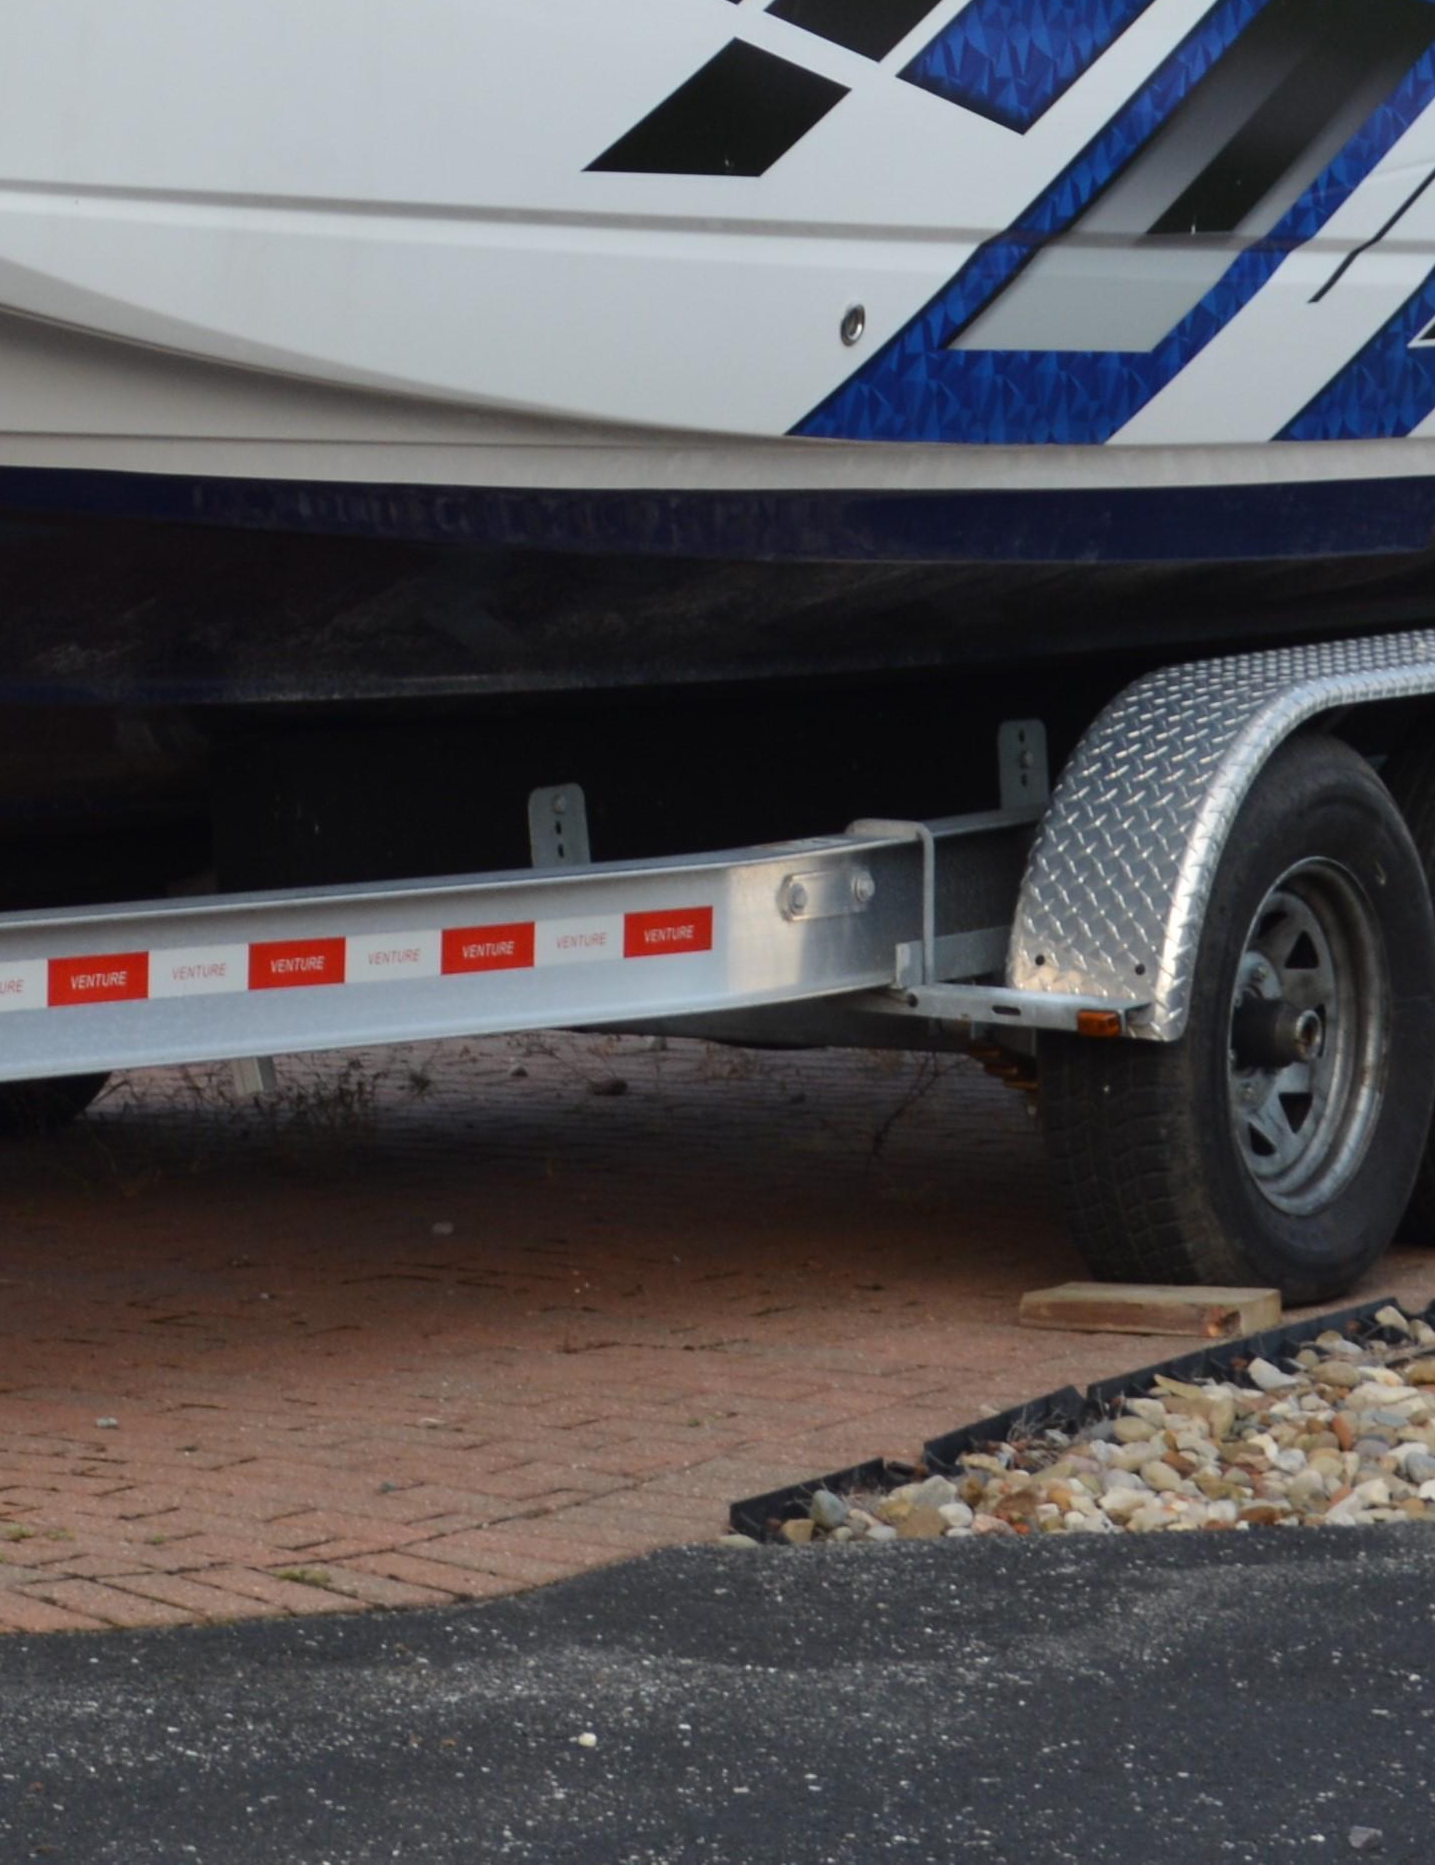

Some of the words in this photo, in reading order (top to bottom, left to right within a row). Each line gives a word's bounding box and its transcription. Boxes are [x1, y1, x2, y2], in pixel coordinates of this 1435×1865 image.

[70, 971, 128, 990] VENTURE
[172, 963, 226, 980] VENTURE
[270, 956, 325, 973] VENTURE
[368, 948, 421, 965] VENTURE
[462, 941, 514, 959] VENTURE
[556, 932, 607, 949] VENTURE
[644, 925, 695, 943] VENTURE
